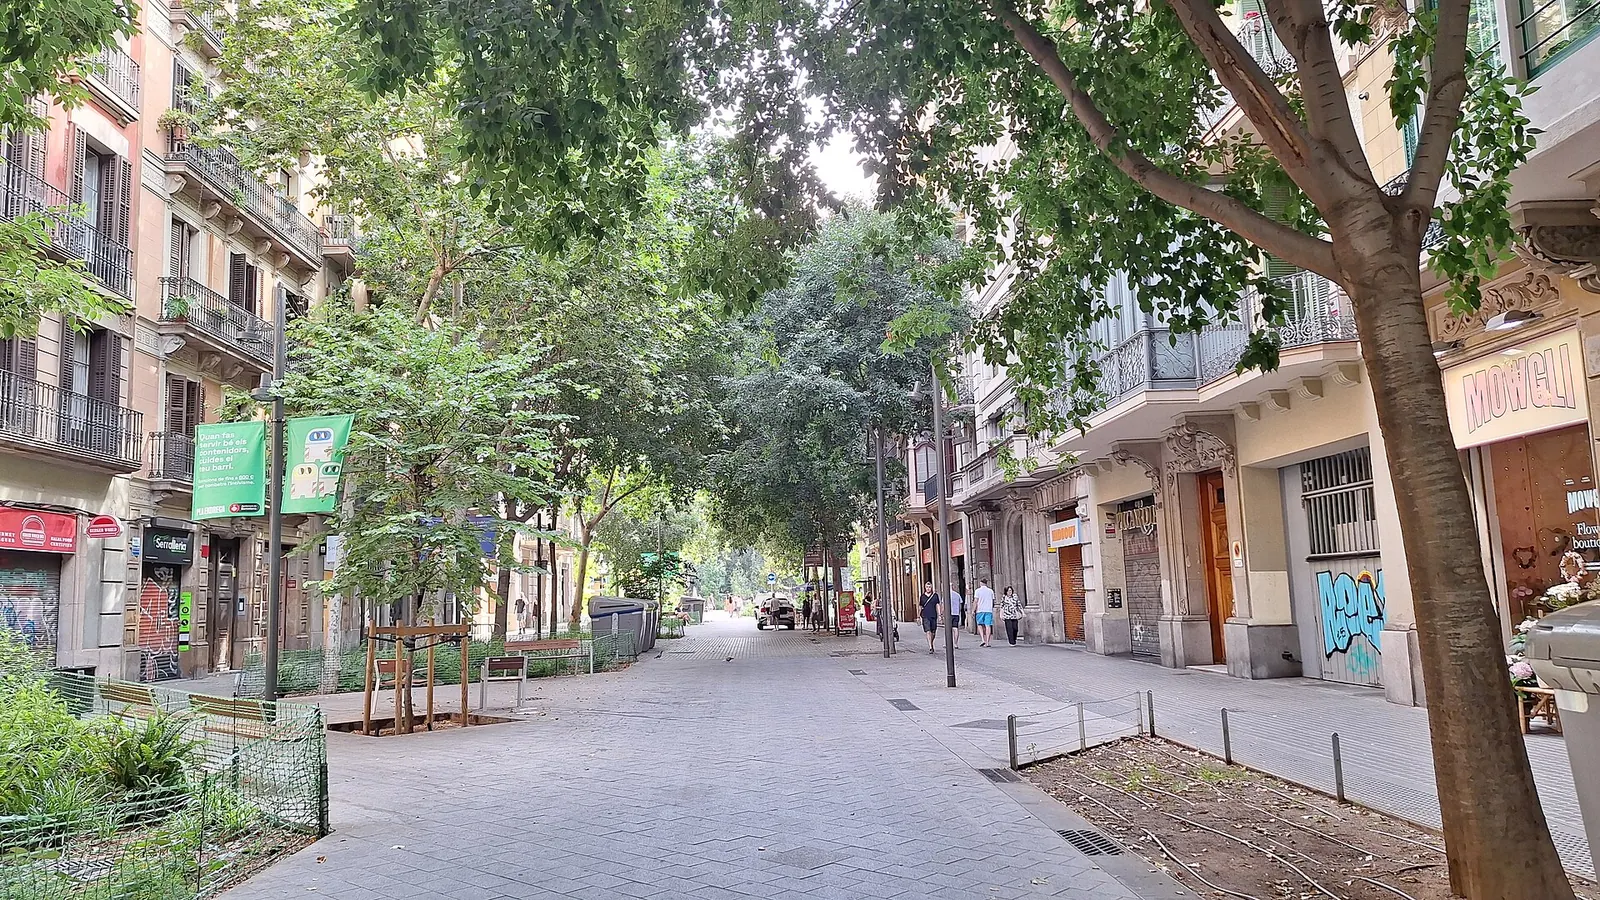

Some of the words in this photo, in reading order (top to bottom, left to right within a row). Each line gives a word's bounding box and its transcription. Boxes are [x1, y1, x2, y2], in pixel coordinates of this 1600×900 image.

[1462, 343, 1576, 434] MOWGLI
[200, 433, 220, 441] Quan
[199, 440, 221, 448] servir
[199, 447, 249, 456] contenidors,
[199, 456, 224, 464] cuides
[212, 462, 234, 471] barri.
[155, 537, 187, 551] Serralleria
